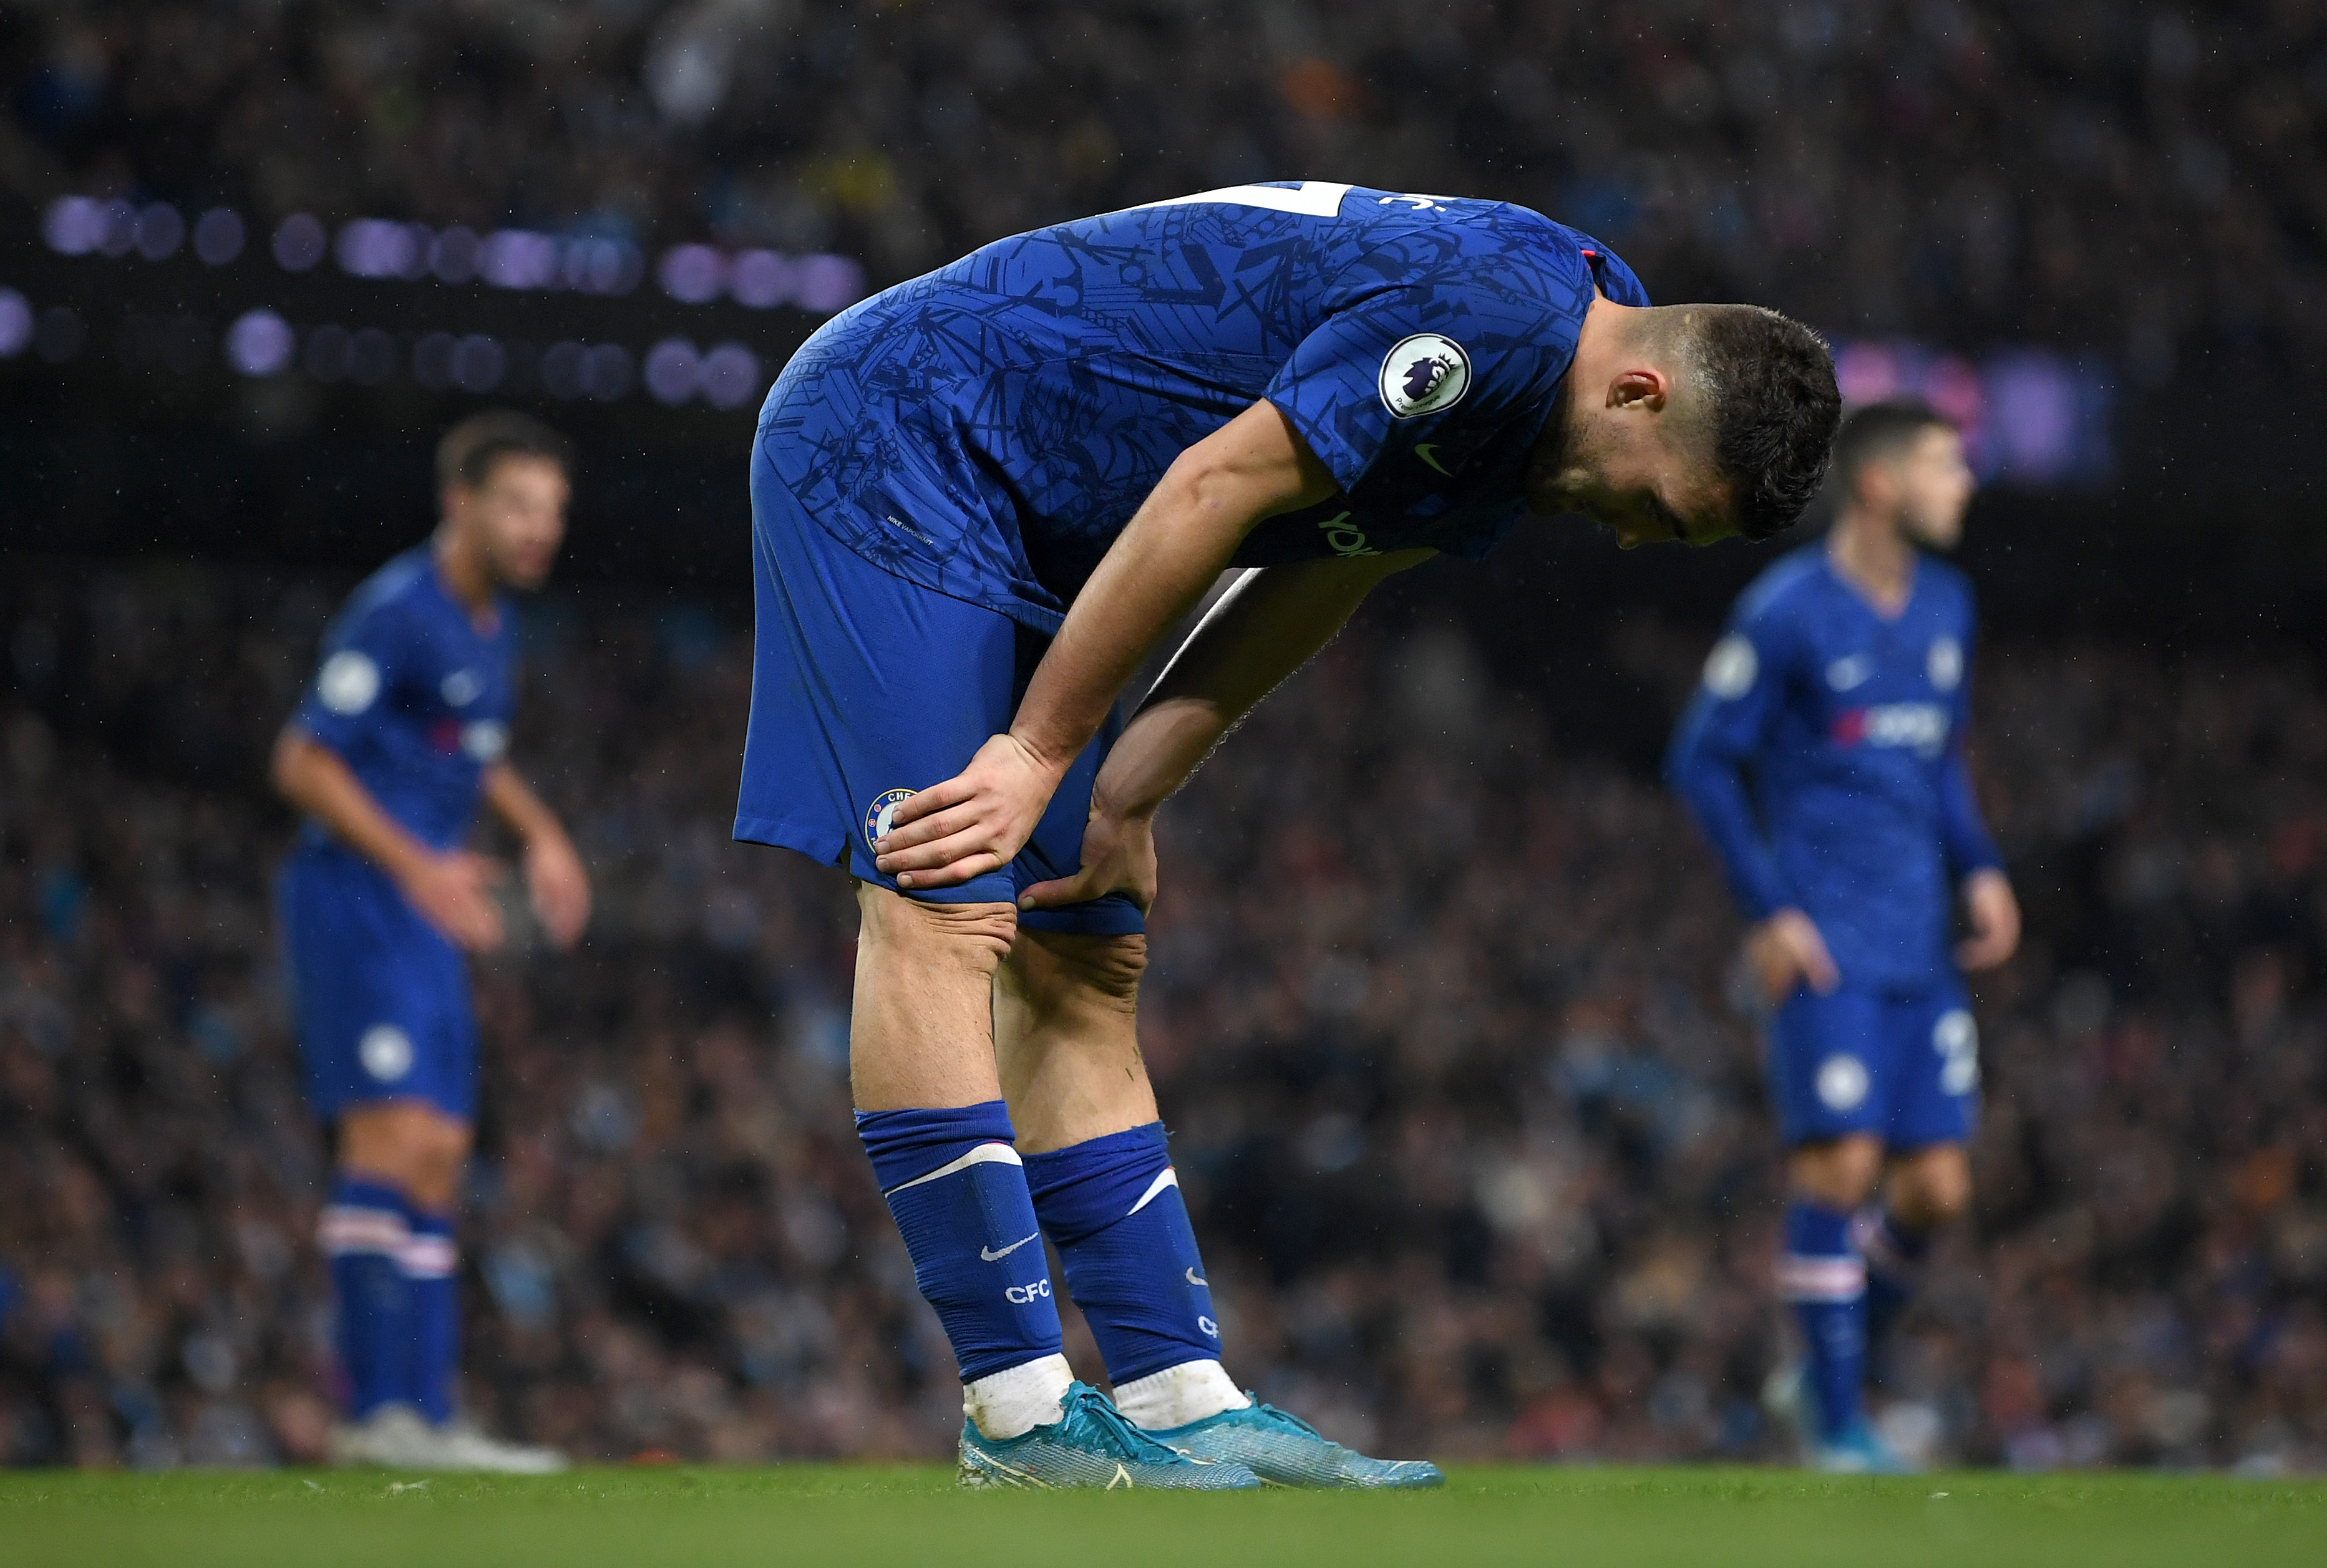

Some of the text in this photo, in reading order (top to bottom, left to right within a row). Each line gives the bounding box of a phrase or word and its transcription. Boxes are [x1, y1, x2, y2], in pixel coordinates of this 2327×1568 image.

[887, 515, 933, 546] NIKE VAPORKNIT
[1004, 1279, 1050, 1304] CFC
